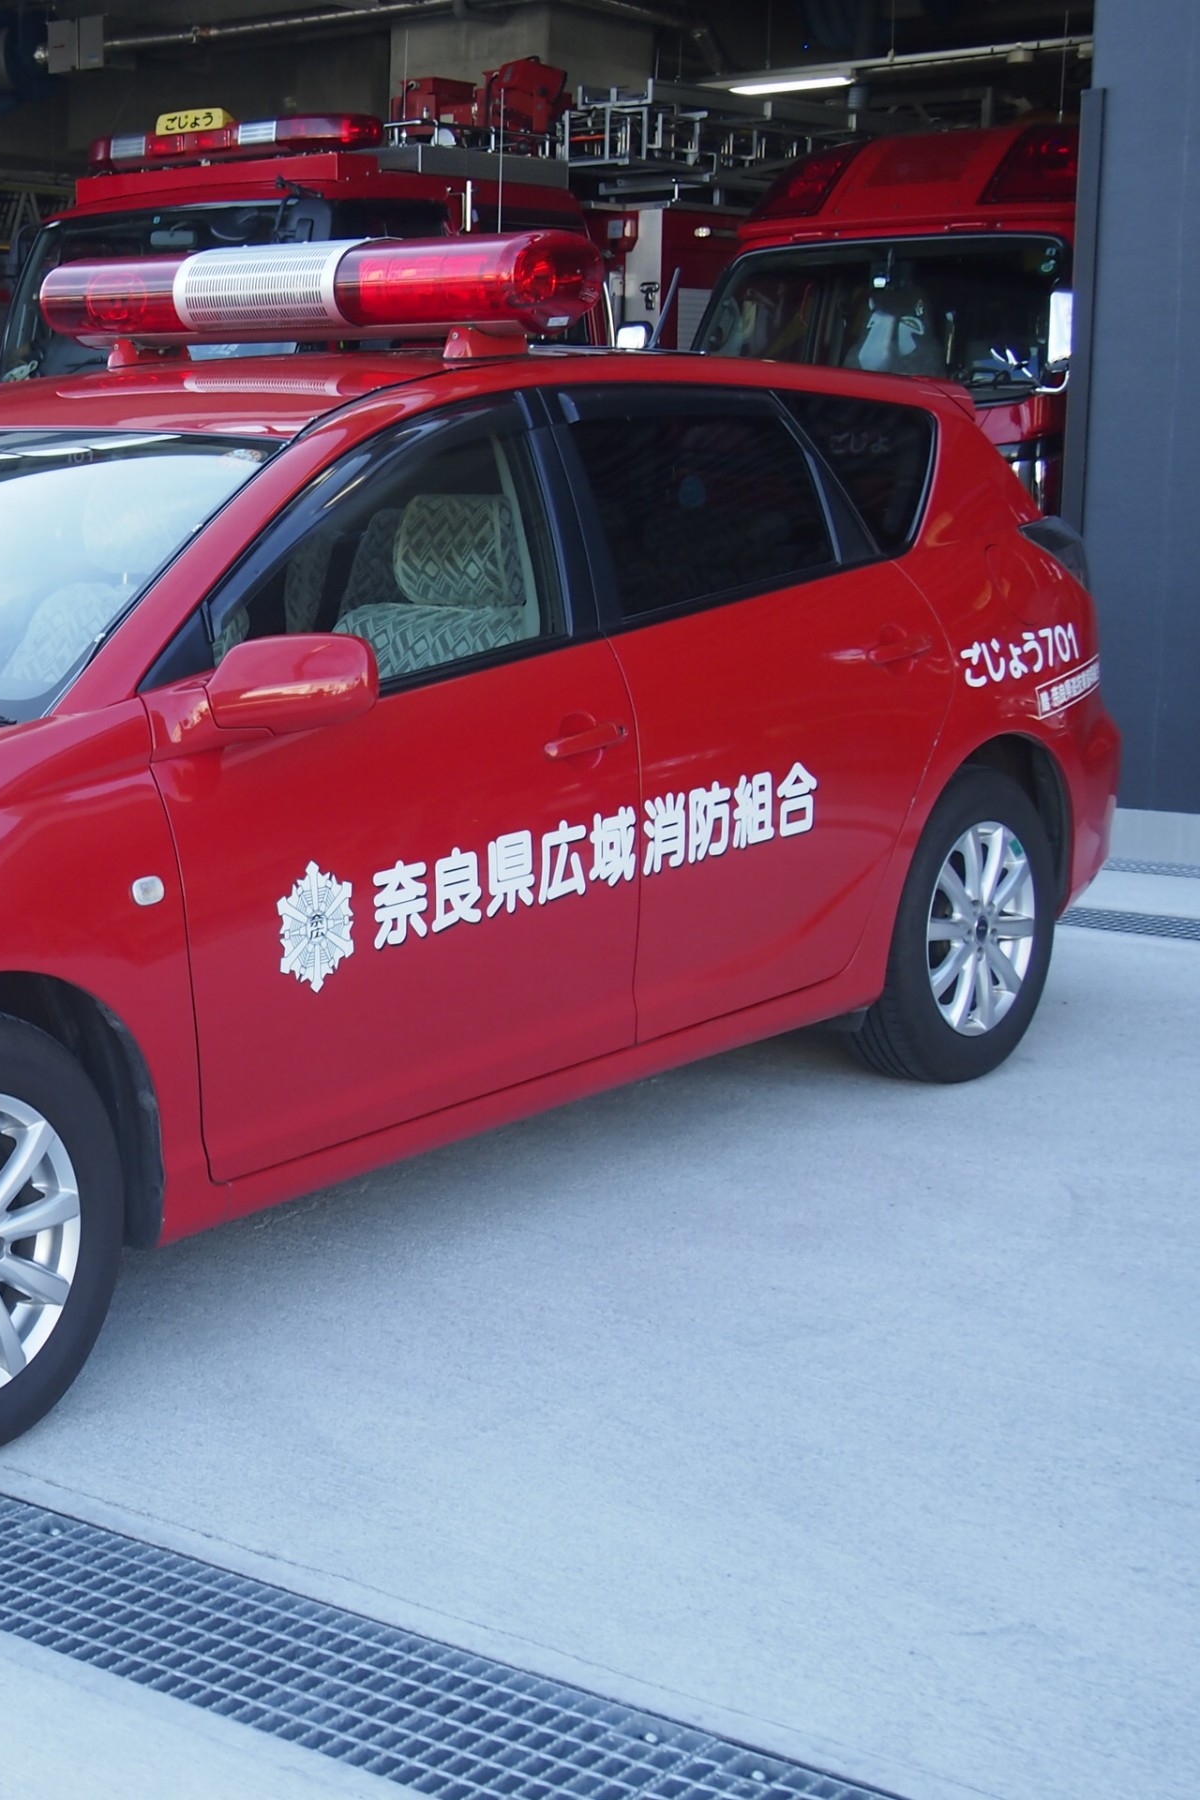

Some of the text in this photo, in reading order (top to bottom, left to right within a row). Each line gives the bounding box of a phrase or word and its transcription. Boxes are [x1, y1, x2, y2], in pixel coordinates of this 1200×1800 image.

[165, 111, 214, 131] ごじょう
[960, 622, 1080, 688] ごじょう701
[372, 761, 818, 951] 奈良県広域消防組合
